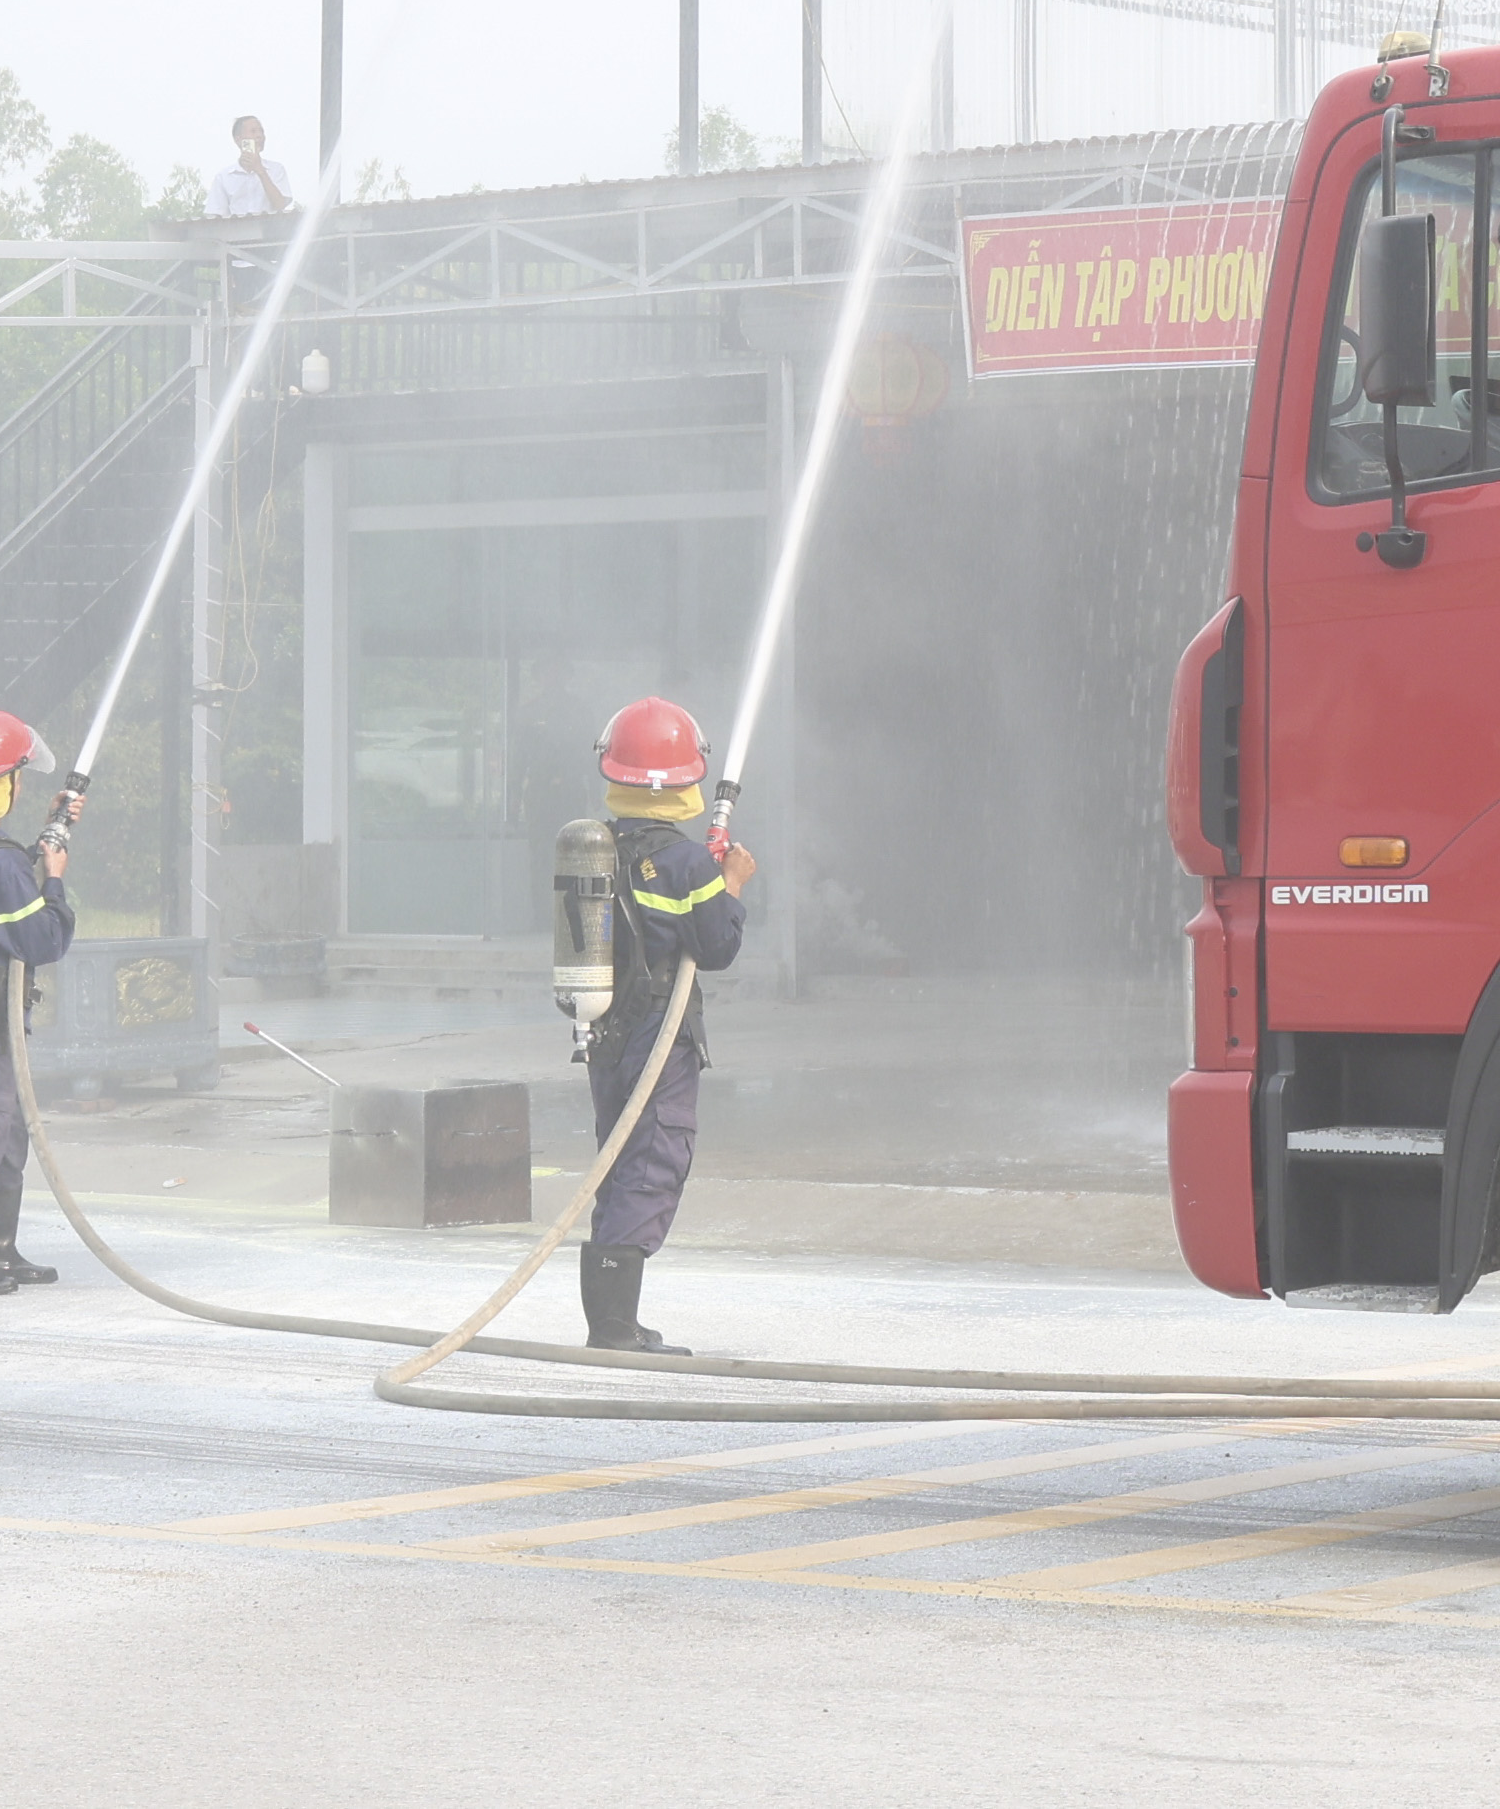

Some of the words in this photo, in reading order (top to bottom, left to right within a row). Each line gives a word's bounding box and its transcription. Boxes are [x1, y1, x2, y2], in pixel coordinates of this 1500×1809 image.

[985, 238, 1065, 333] DIỄN
[1074, 245, 1136, 342] TẬP
[1144, 245, 1266, 324] PHƯƠN
[1272, 884, 1429, 904] EVERDIGM
